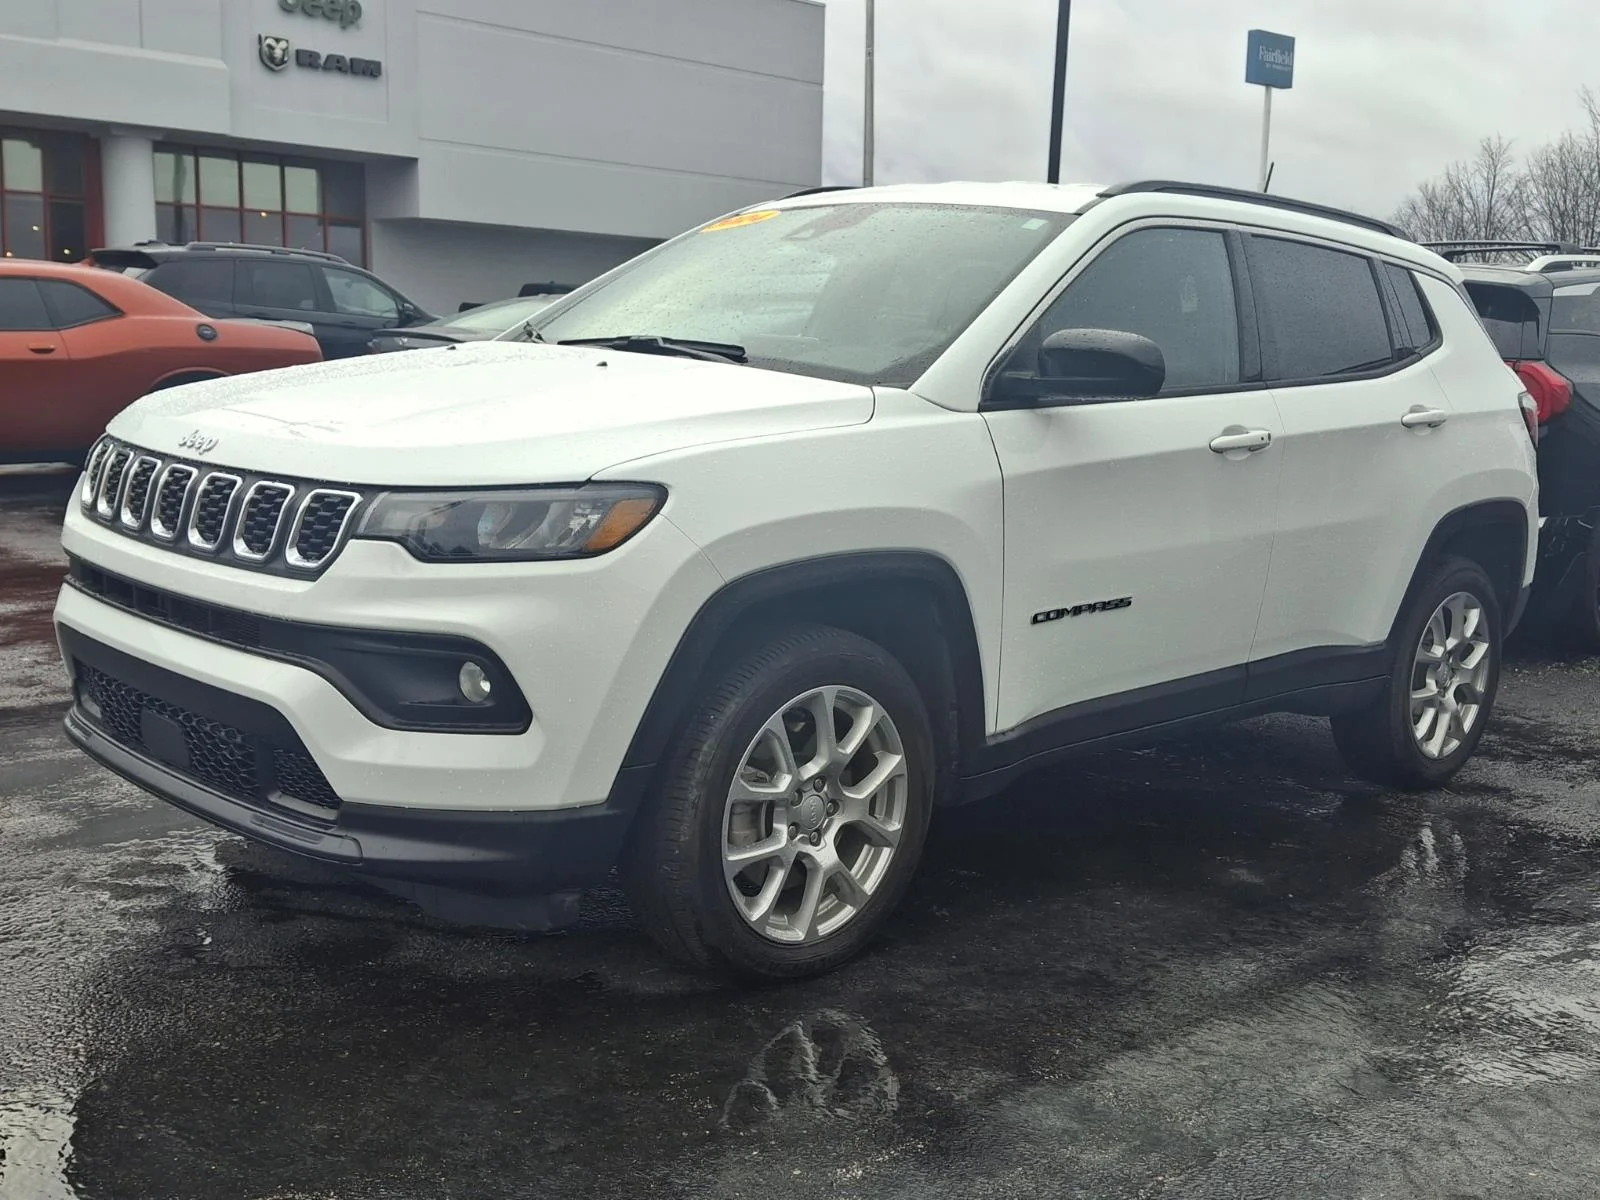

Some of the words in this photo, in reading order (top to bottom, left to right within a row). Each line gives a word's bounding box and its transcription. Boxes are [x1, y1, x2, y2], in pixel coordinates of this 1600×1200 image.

[295, 48, 382, 77] RAM
[1259, 45, 1293, 66] Fairfield
[178, 429, 219, 456] Jeep
[1030, 596, 1133, 625] COMPASS
